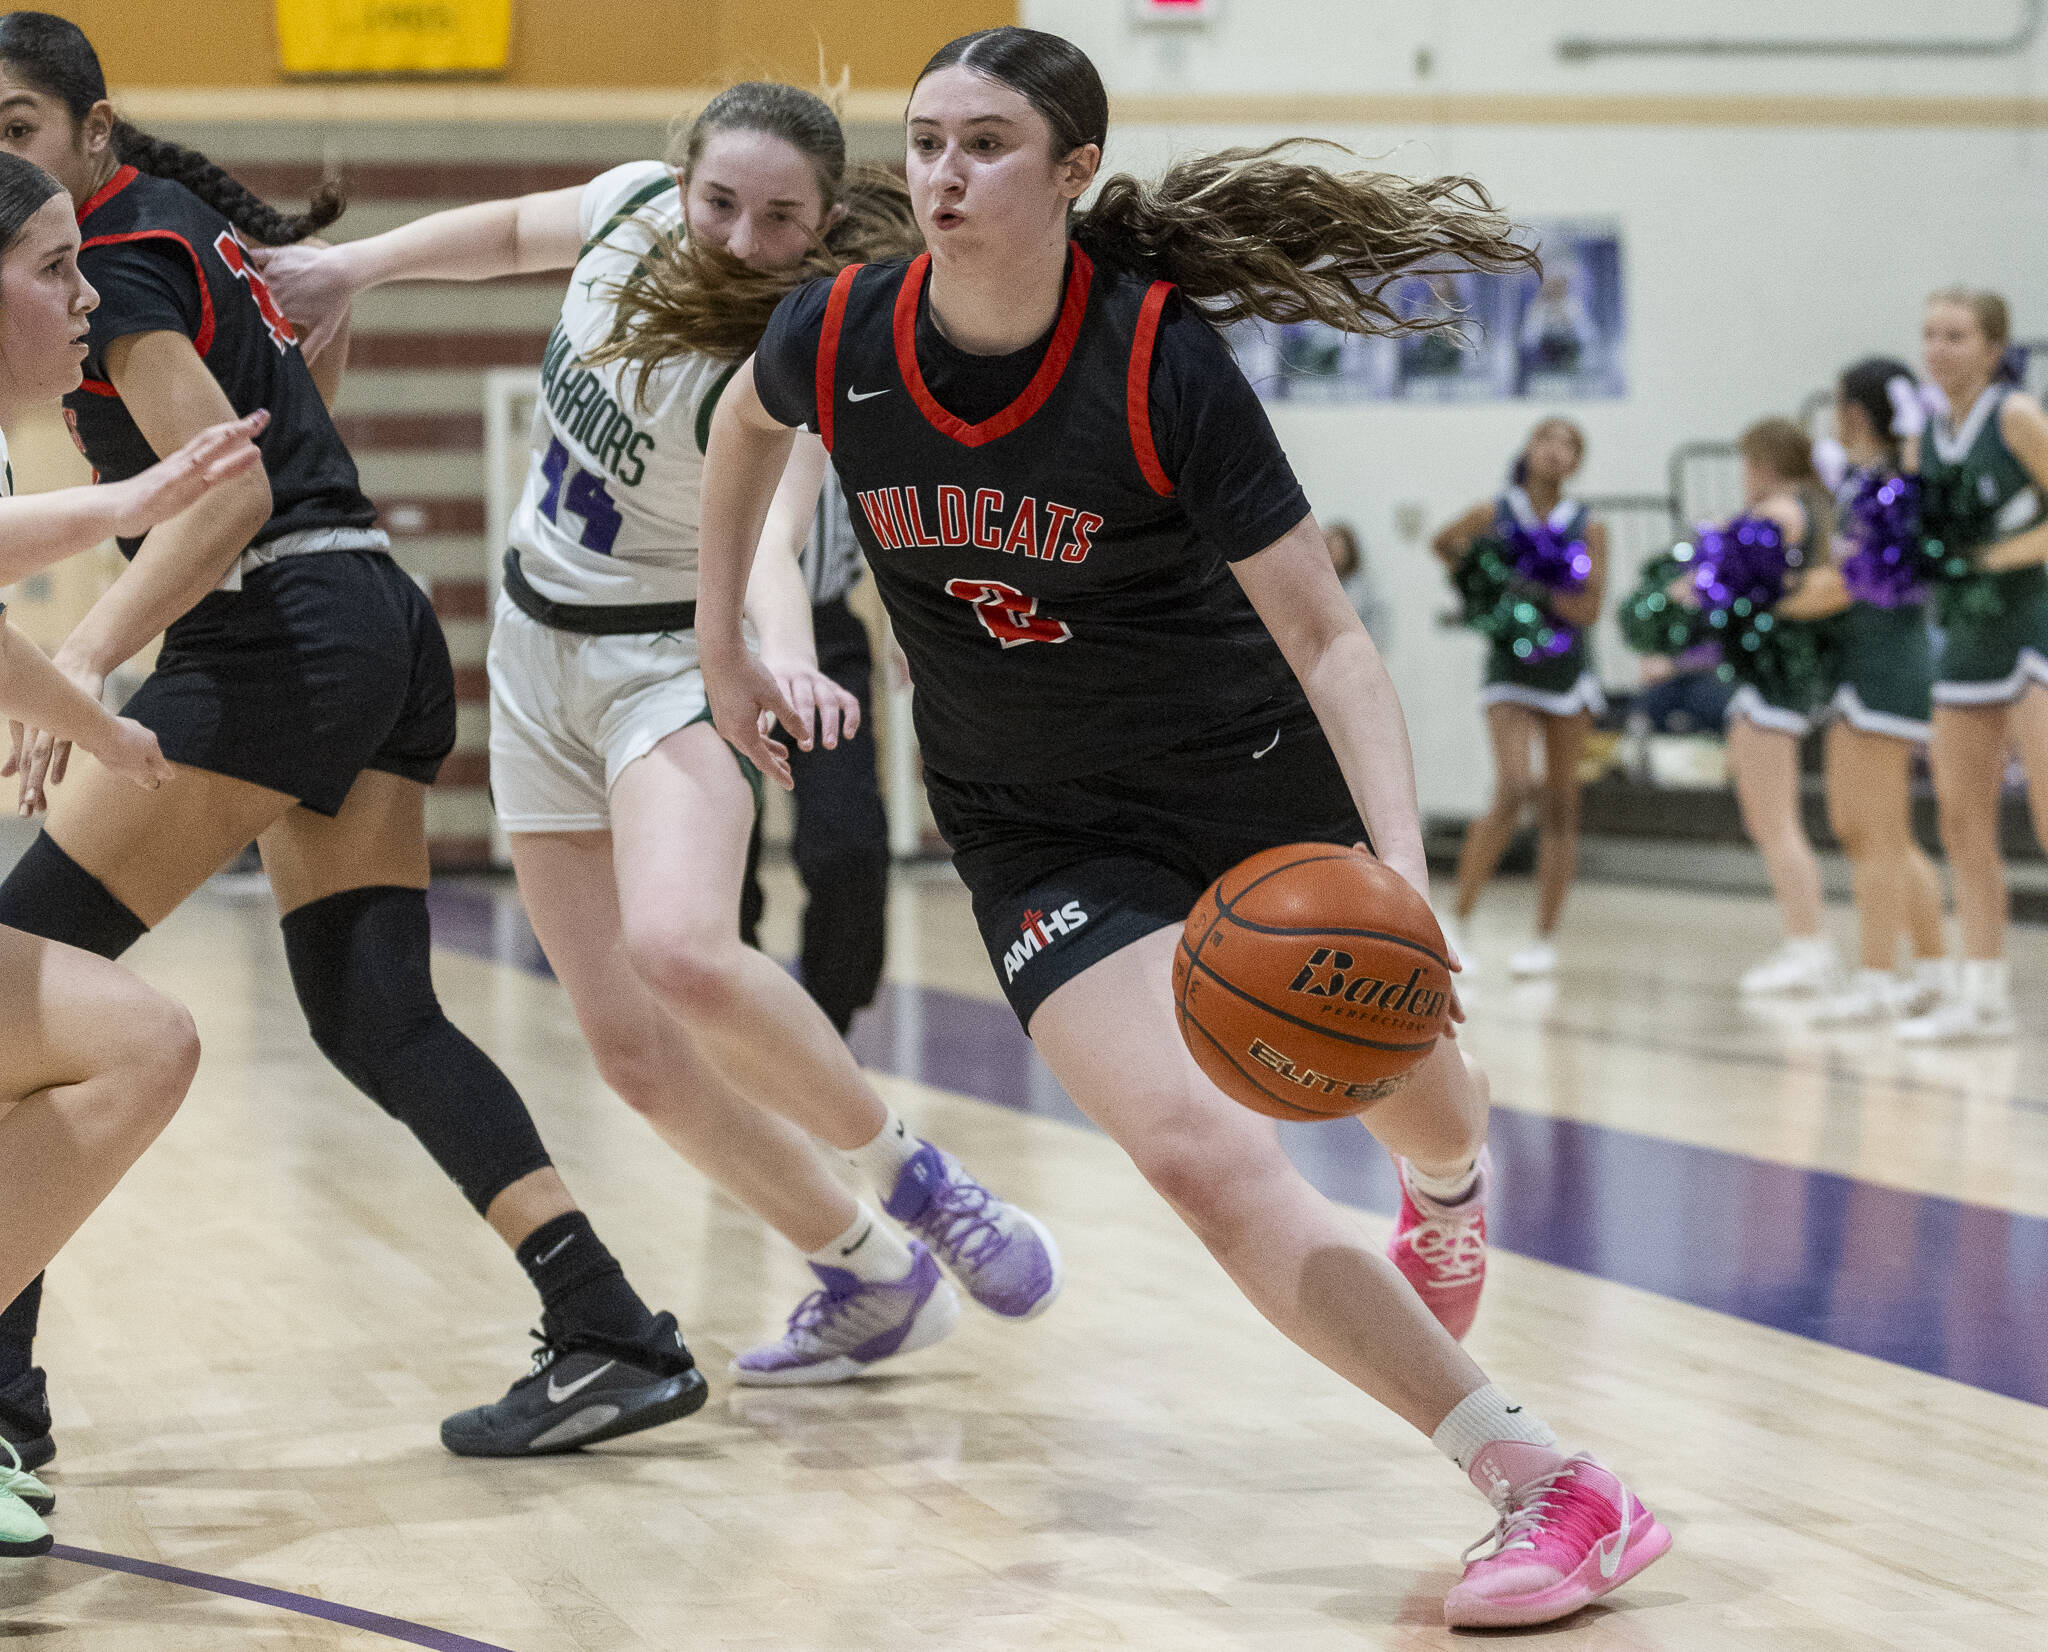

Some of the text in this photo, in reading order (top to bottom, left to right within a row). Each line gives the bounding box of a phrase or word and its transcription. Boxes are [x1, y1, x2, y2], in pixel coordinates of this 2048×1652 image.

[538, 436, 622, 556] 14
[857, 485, 1104, 564] WILDCATS
[944, 578, 1074, 649] 2
[1003, 900, 1088, 984] AMHS
[1288, 948, 1445, 1018] Baden
[1321, 1004, 1426, 1032] PERFECTION
